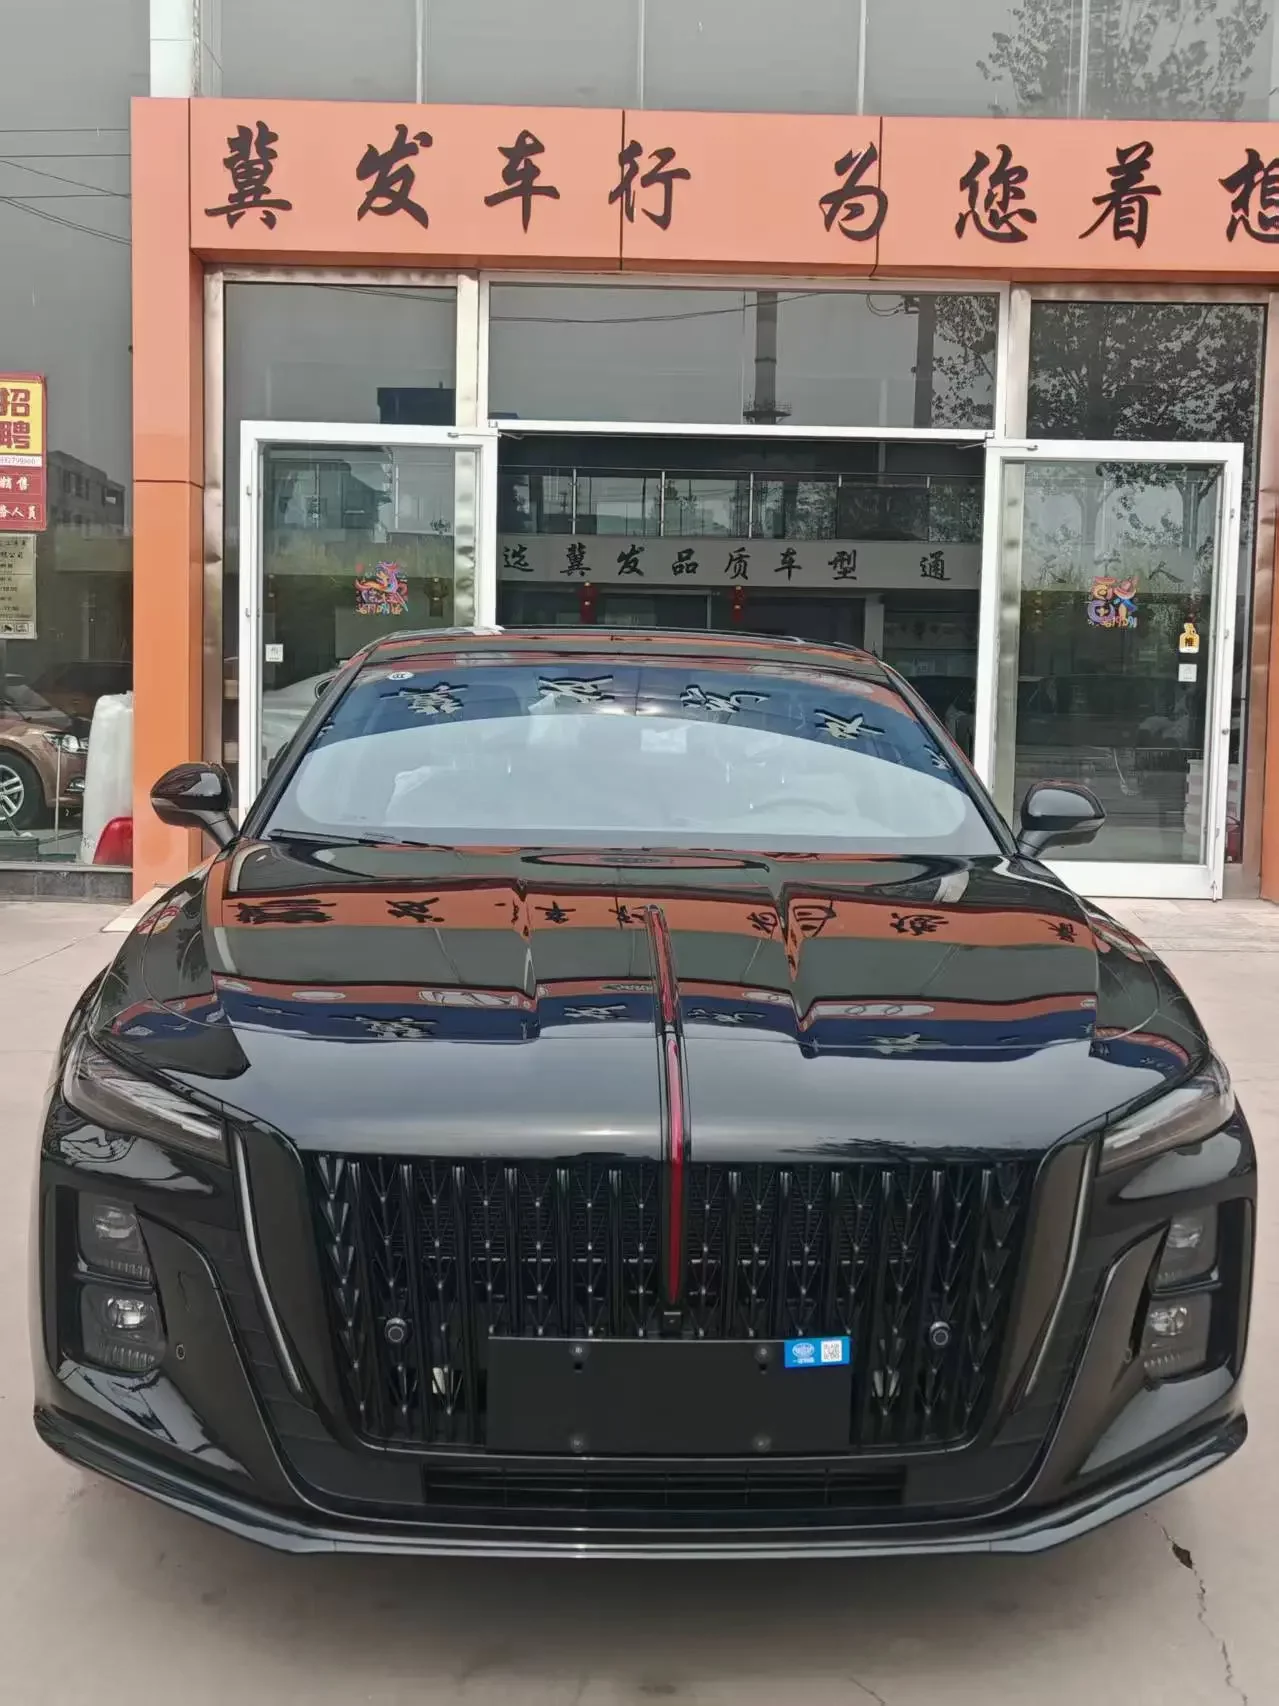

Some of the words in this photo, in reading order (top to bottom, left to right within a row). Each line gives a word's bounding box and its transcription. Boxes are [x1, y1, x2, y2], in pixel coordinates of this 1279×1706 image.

[204, 120, 691, 233] 冀发车行
[0, 387, 31, 450] 招聘
[503, 542, 858, 581] 选冀发品质车型
[920, 550, 952, 582] 通
